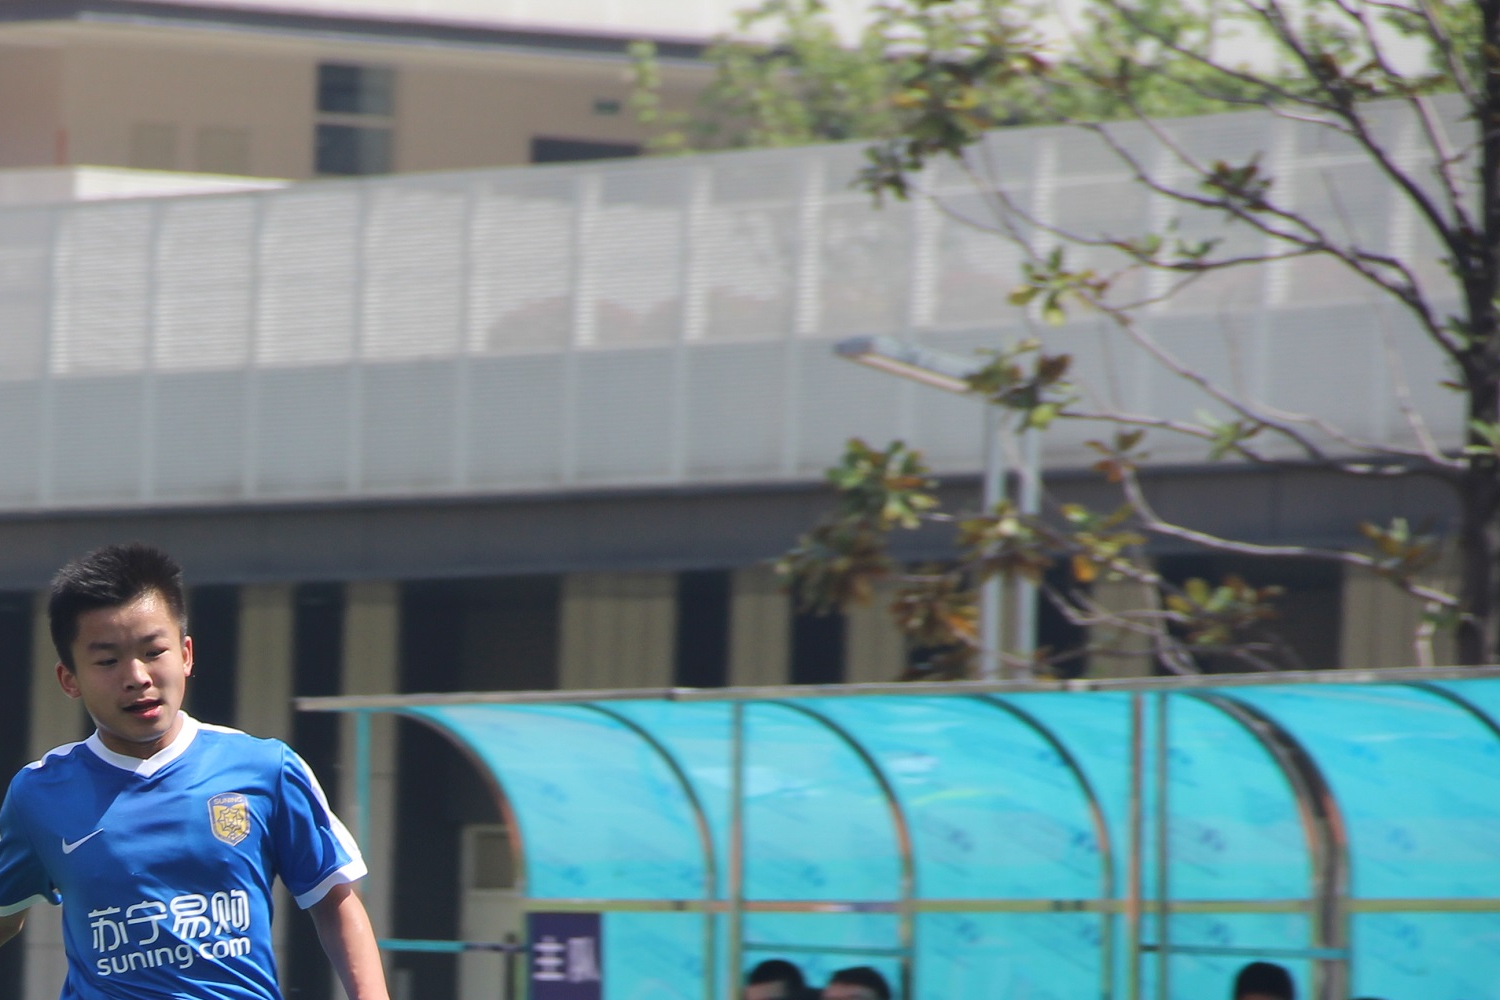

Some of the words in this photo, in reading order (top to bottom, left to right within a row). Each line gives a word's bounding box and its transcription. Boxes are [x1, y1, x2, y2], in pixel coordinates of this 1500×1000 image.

[88, 889, 250, 953] 苏宁易购
[96, 937, 250, 976] suning.com
